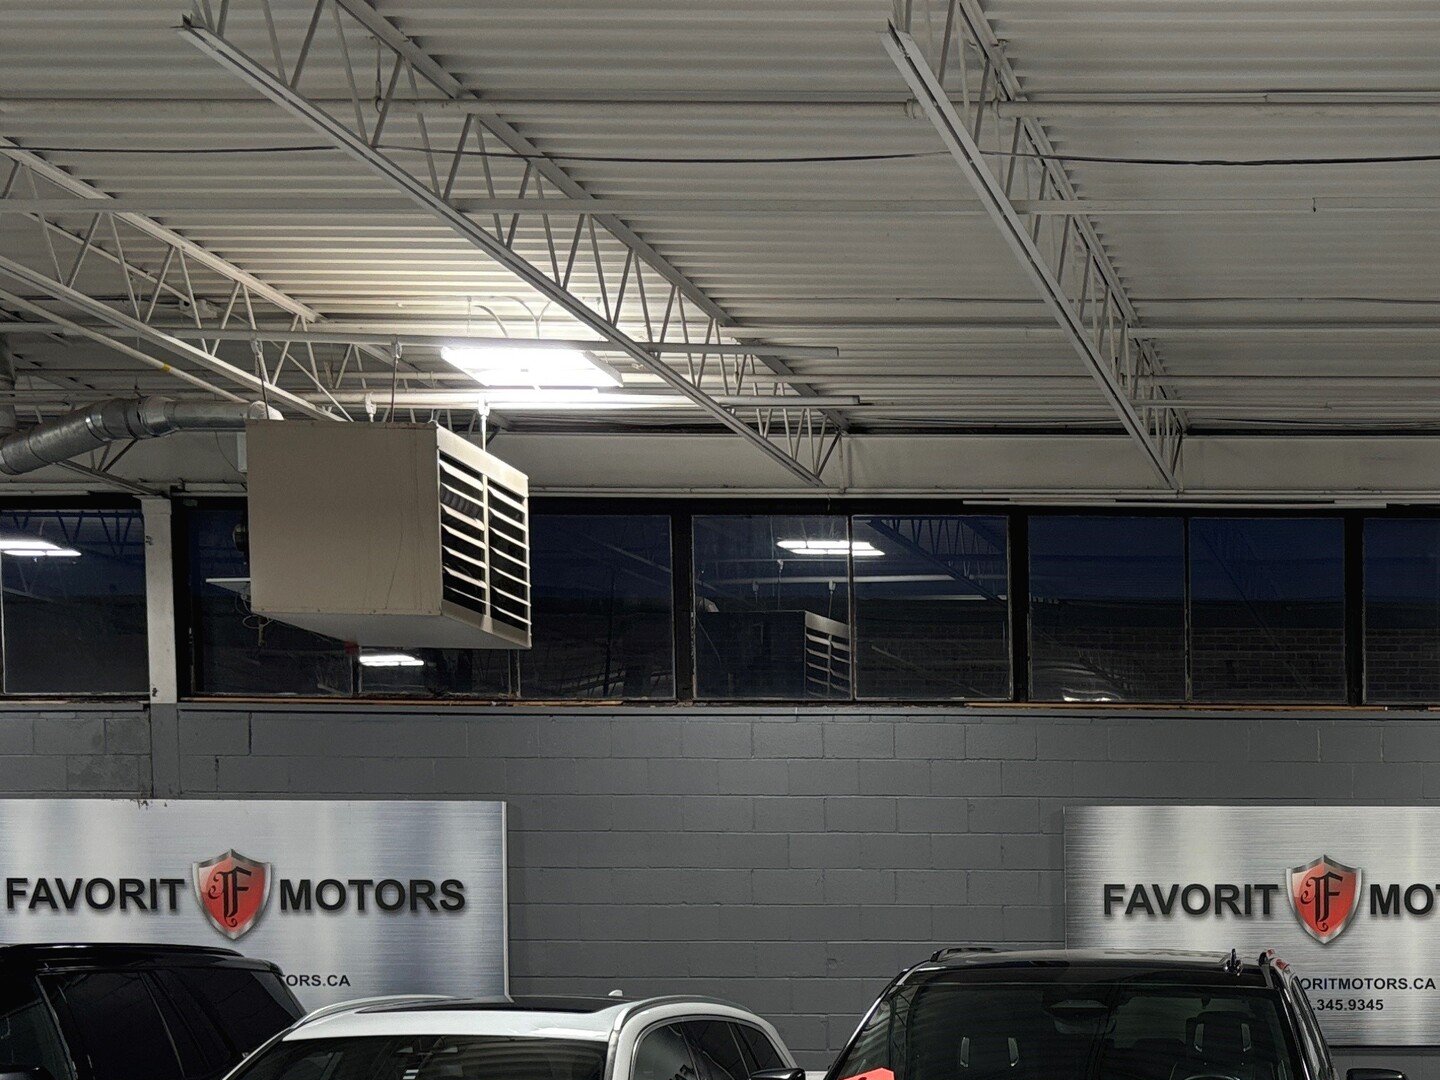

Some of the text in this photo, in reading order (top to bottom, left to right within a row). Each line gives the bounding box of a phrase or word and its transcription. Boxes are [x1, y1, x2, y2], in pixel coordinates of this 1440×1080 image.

[6, 877, 185, 910] FAVORIT
[281, 878, 466, 912] MOTORS
[1103, 883, 1279, 916] FAVORIT
[283, 974, 351, 988] ORS.CA
[1300, 977, 1437, 990] ORITMOTORS.CA
[1312, 999, 1384, 1011] .345.9345
